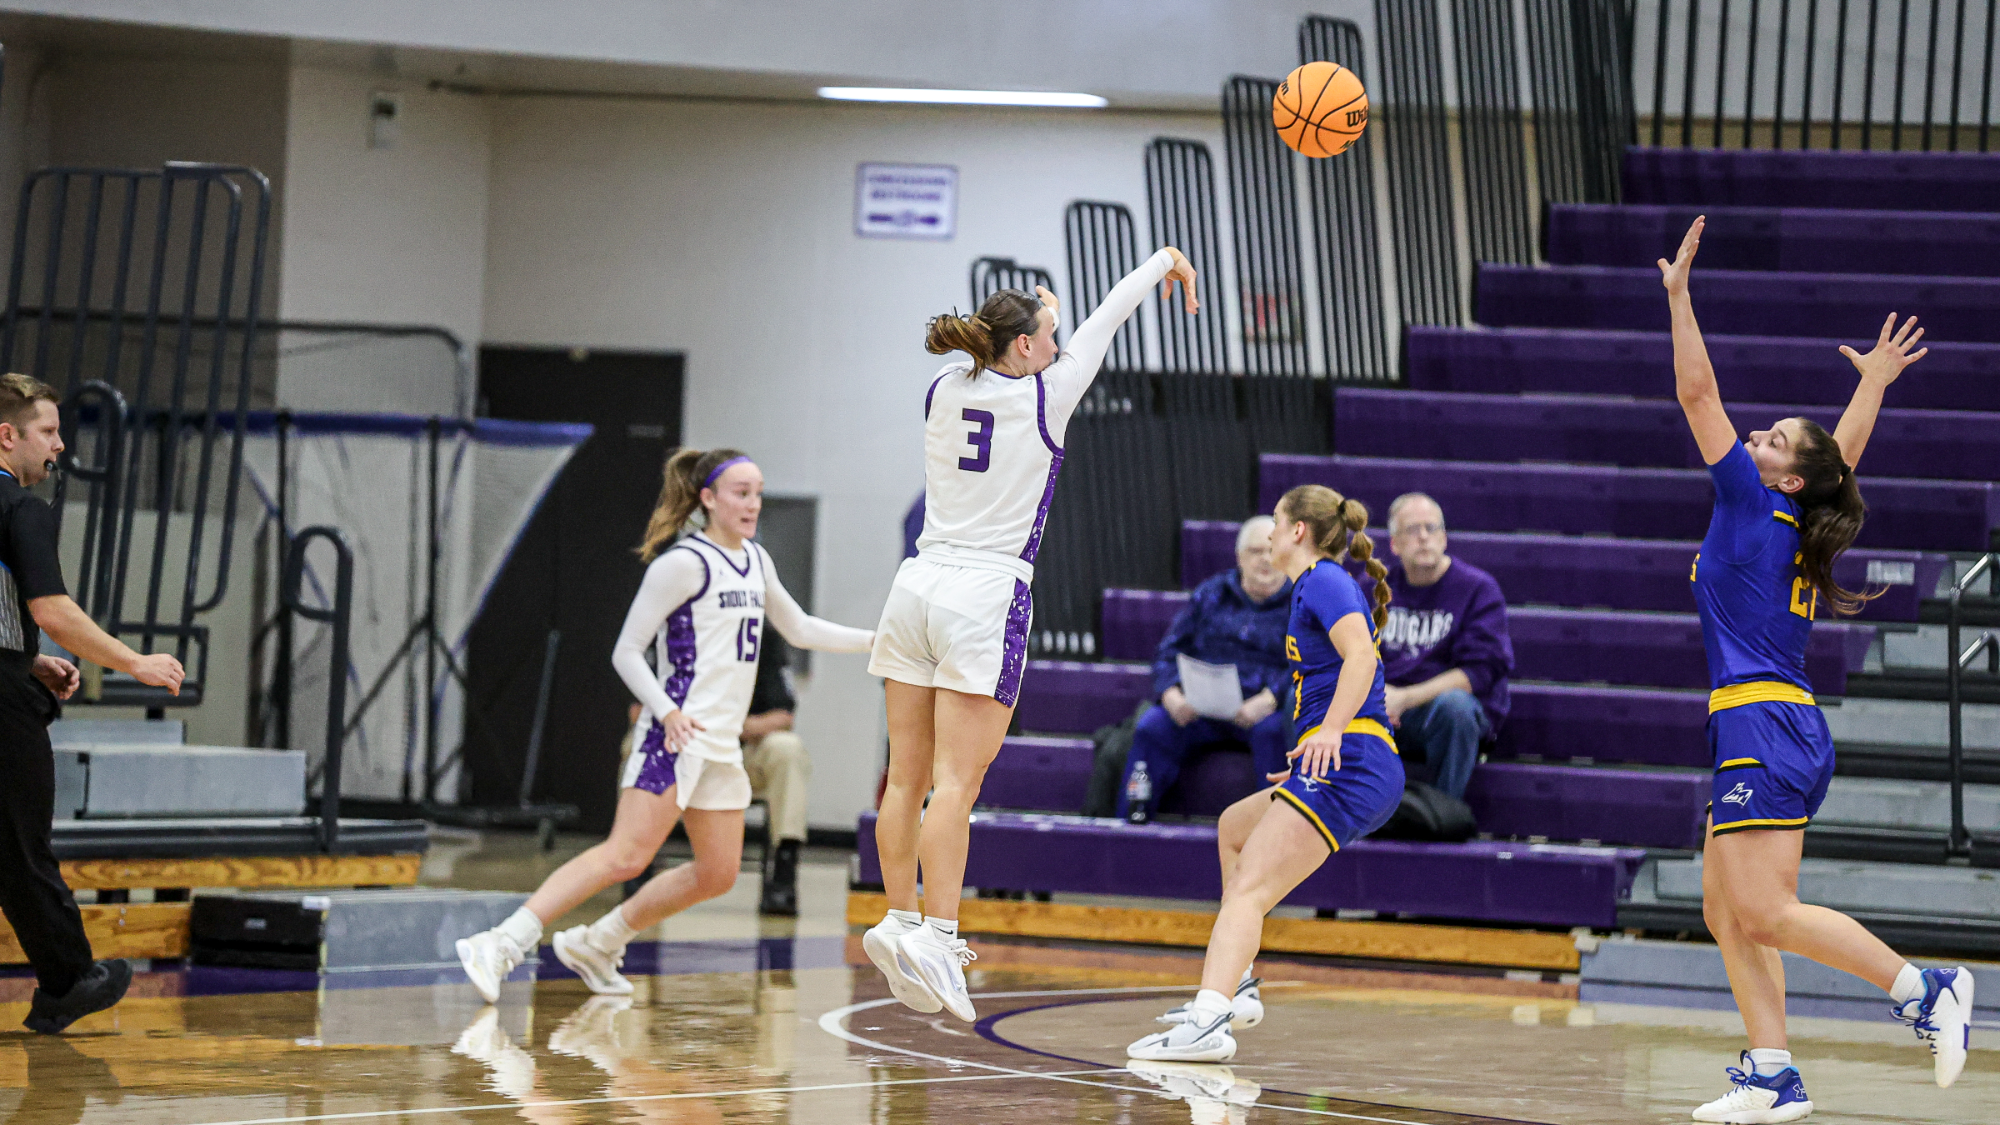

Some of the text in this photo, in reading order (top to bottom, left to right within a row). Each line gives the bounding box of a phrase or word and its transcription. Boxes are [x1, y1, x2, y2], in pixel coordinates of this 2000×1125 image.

[1345, 104, 1368, 128] Wil
[958, 408, 994, 473] 3
[719, 590, 766, 609] SIOUX FALL
[736, 617, 759, 662] 15
[1380, 611, 1454, 646] OUGARS
